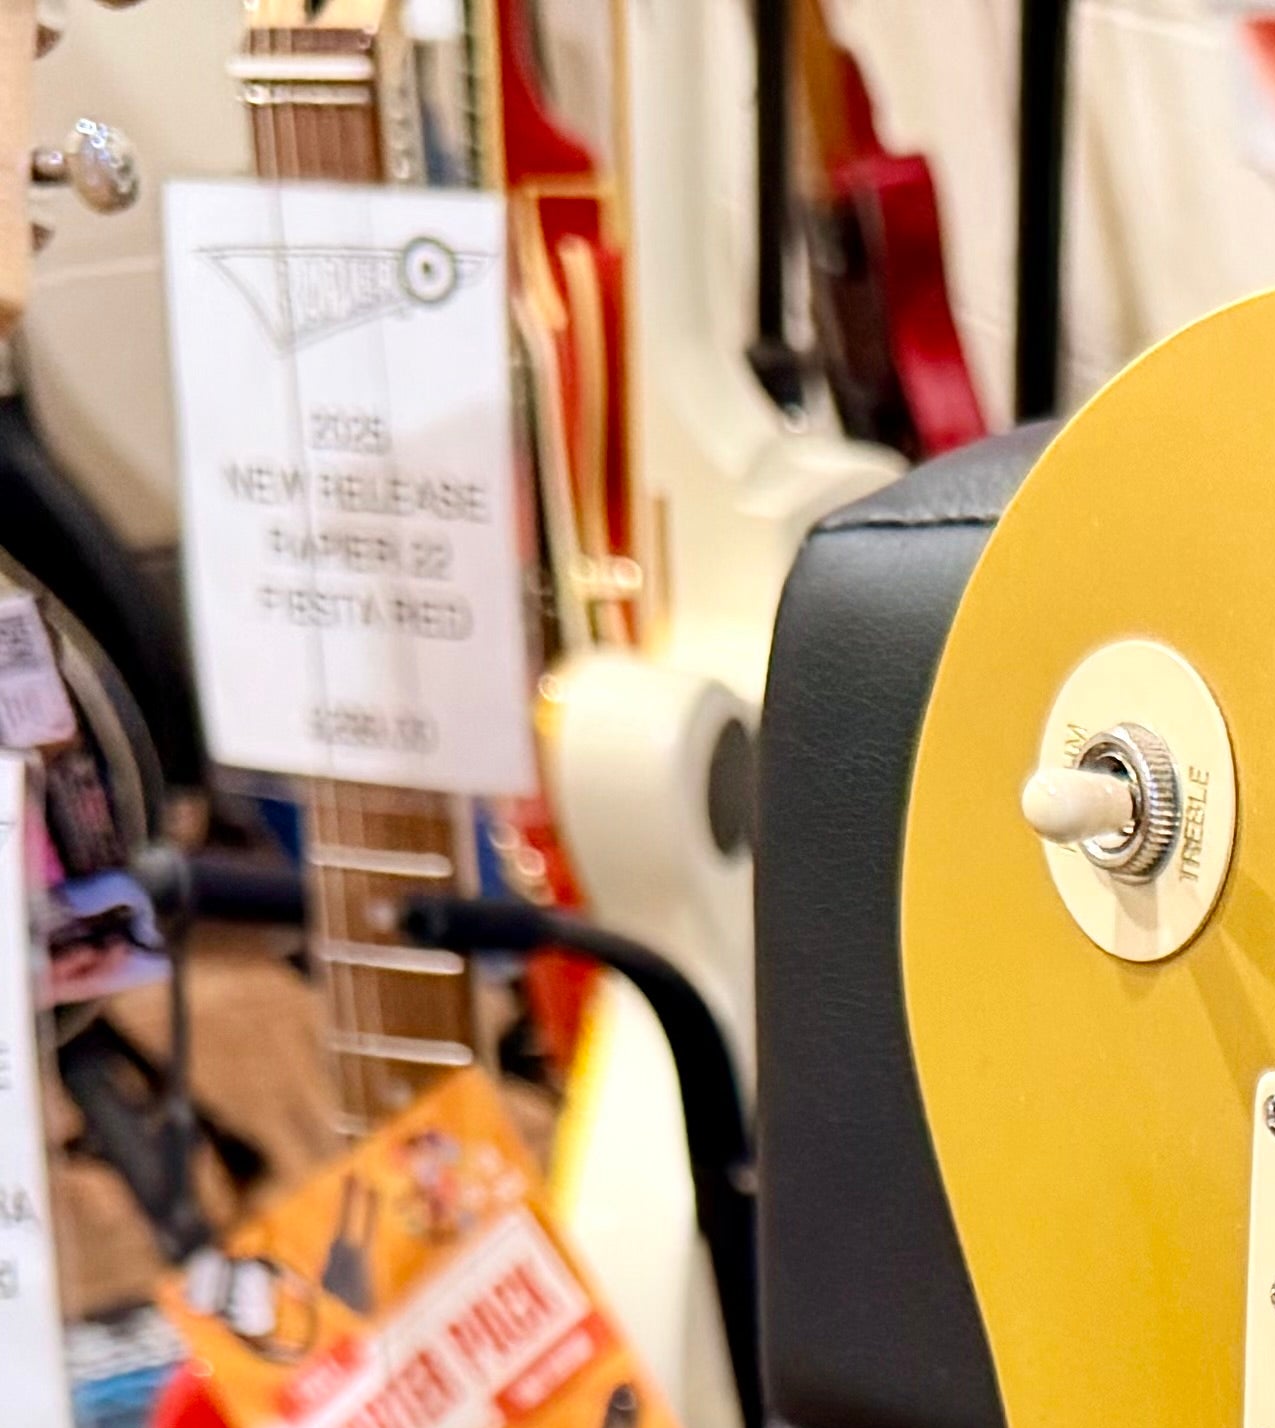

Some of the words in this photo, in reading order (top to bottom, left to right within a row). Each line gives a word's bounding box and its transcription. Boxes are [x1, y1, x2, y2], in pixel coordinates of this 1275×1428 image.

[224, 462, 303, 506] NEW
[319, 471, 491, 525] RELEASE
[1180, 765, 1211, 883] TREBLE
[447, 1264, 556, 1376] PACK
